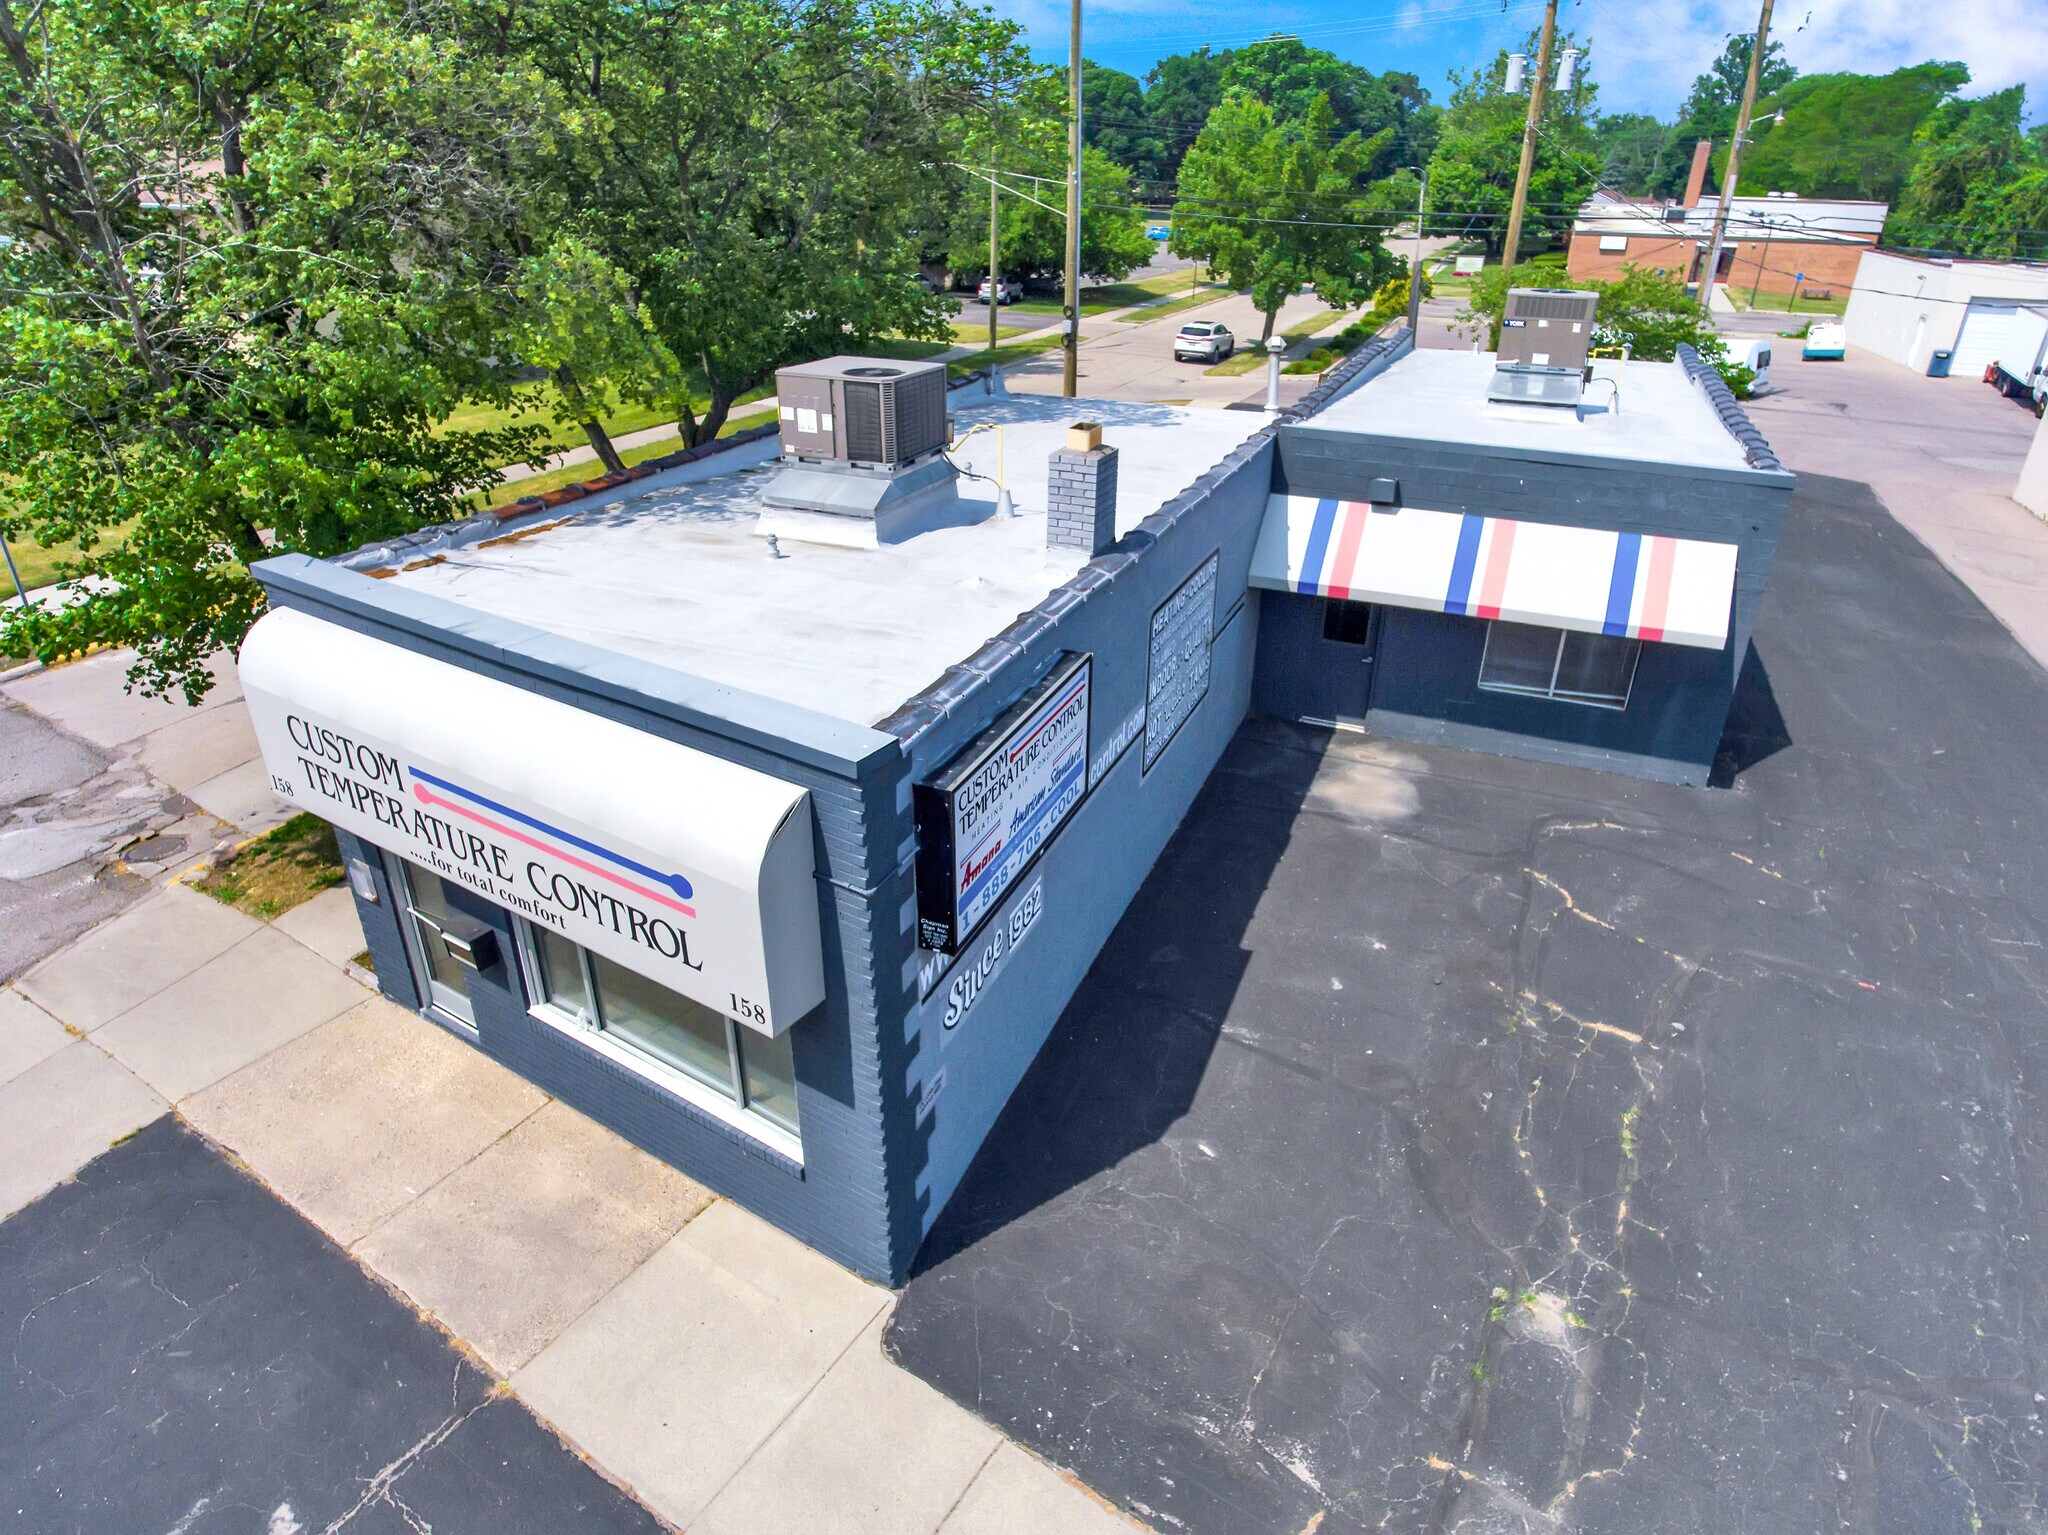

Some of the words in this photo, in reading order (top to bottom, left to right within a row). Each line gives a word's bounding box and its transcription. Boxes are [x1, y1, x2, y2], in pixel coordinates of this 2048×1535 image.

[286, 715, 405, 793] CUSTOM
[1146, 710, 1161, 747] HOT
[271, 774, 294, 797] 158
[959, 748, 1008, 812] CUSTOM
[960, 737, 1039, 836] TEMPERATURE
[1042, 694, 1085, 749] CONTROL
[971, 803, 1003, 841] HEATING
[1018, 774, 1027, 791] AIR
[1033, 723, 1078, 775] CONDITIONING
[297, 756, 514, 883] TEMPERATURE
[526, 862, 704, 972] CONTROL
[960, 827, 1000, 894] Amana
[1008, 784, 1046, 838] American
[457, 866, 495, 895] total
[499, 887, 567, 930] comfort
[920, 918, 948, 929] Chapman
[943, 928, 1004, 1030] Since
[1007, 883, 1042, 951] 1982
[729, 993, 766, 1025] 158
